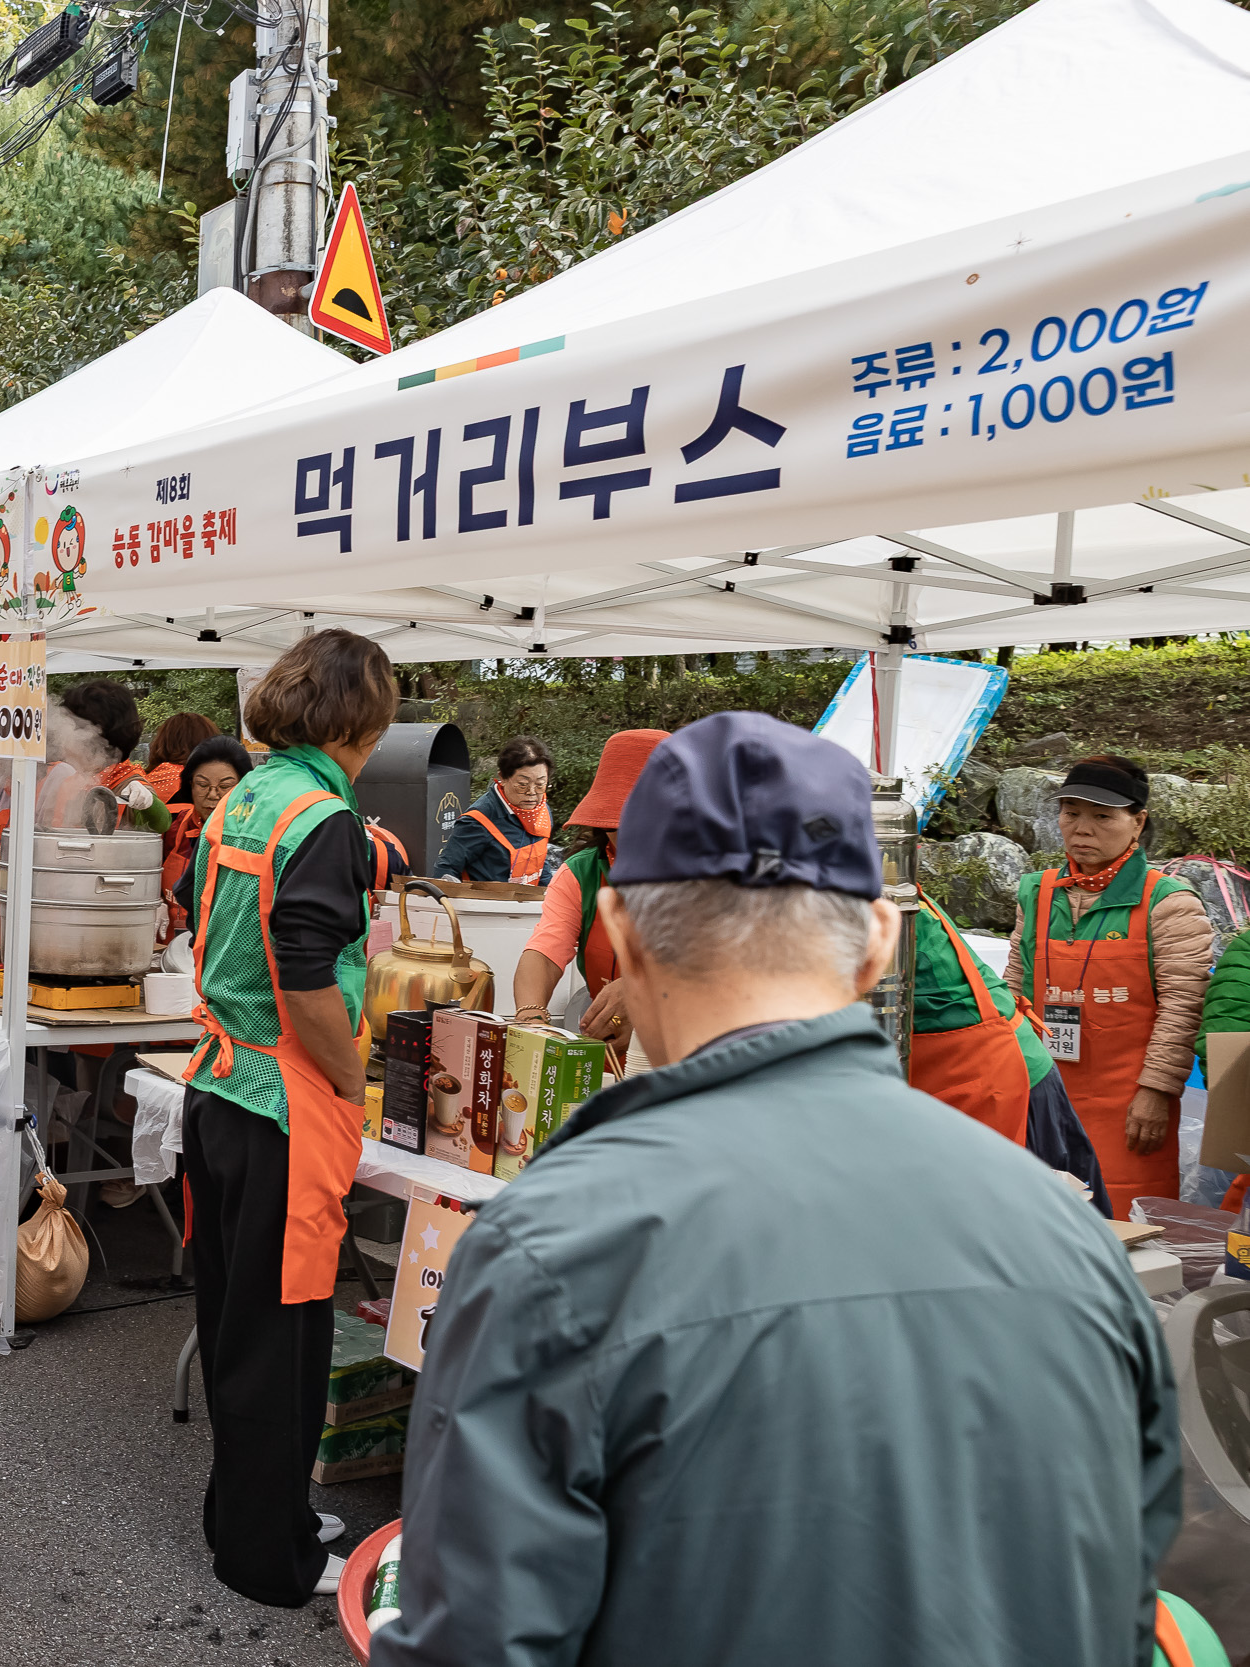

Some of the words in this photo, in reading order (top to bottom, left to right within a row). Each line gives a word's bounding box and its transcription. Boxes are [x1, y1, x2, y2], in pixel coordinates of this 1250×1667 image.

[852, 341, 936, 399] 주류
[976, 280, 1210, 376] 2,000원
[846, 403, 928, 459] 음료
[967, 350, 1175, 442] 1,000원
[155, 472, 192, 505] 제8회
[294, 363, 788, 554] 먹거리부스
[111, 524, 141, 569] 능동
[146, 514, 196, 564] 감마을
[201, 507, 237, 556] 축제
[1092, 986, 1130, 1004] 능동
[1048, 1041, 1074, 1054] 지원
[1049, 1026, 1075, 1040] 행사
[477, 1048, 495, 1111] 쌍화차
[540, 1065, 557, 1130] 생강차
[581, 1061, 593, 1098] 생강차
